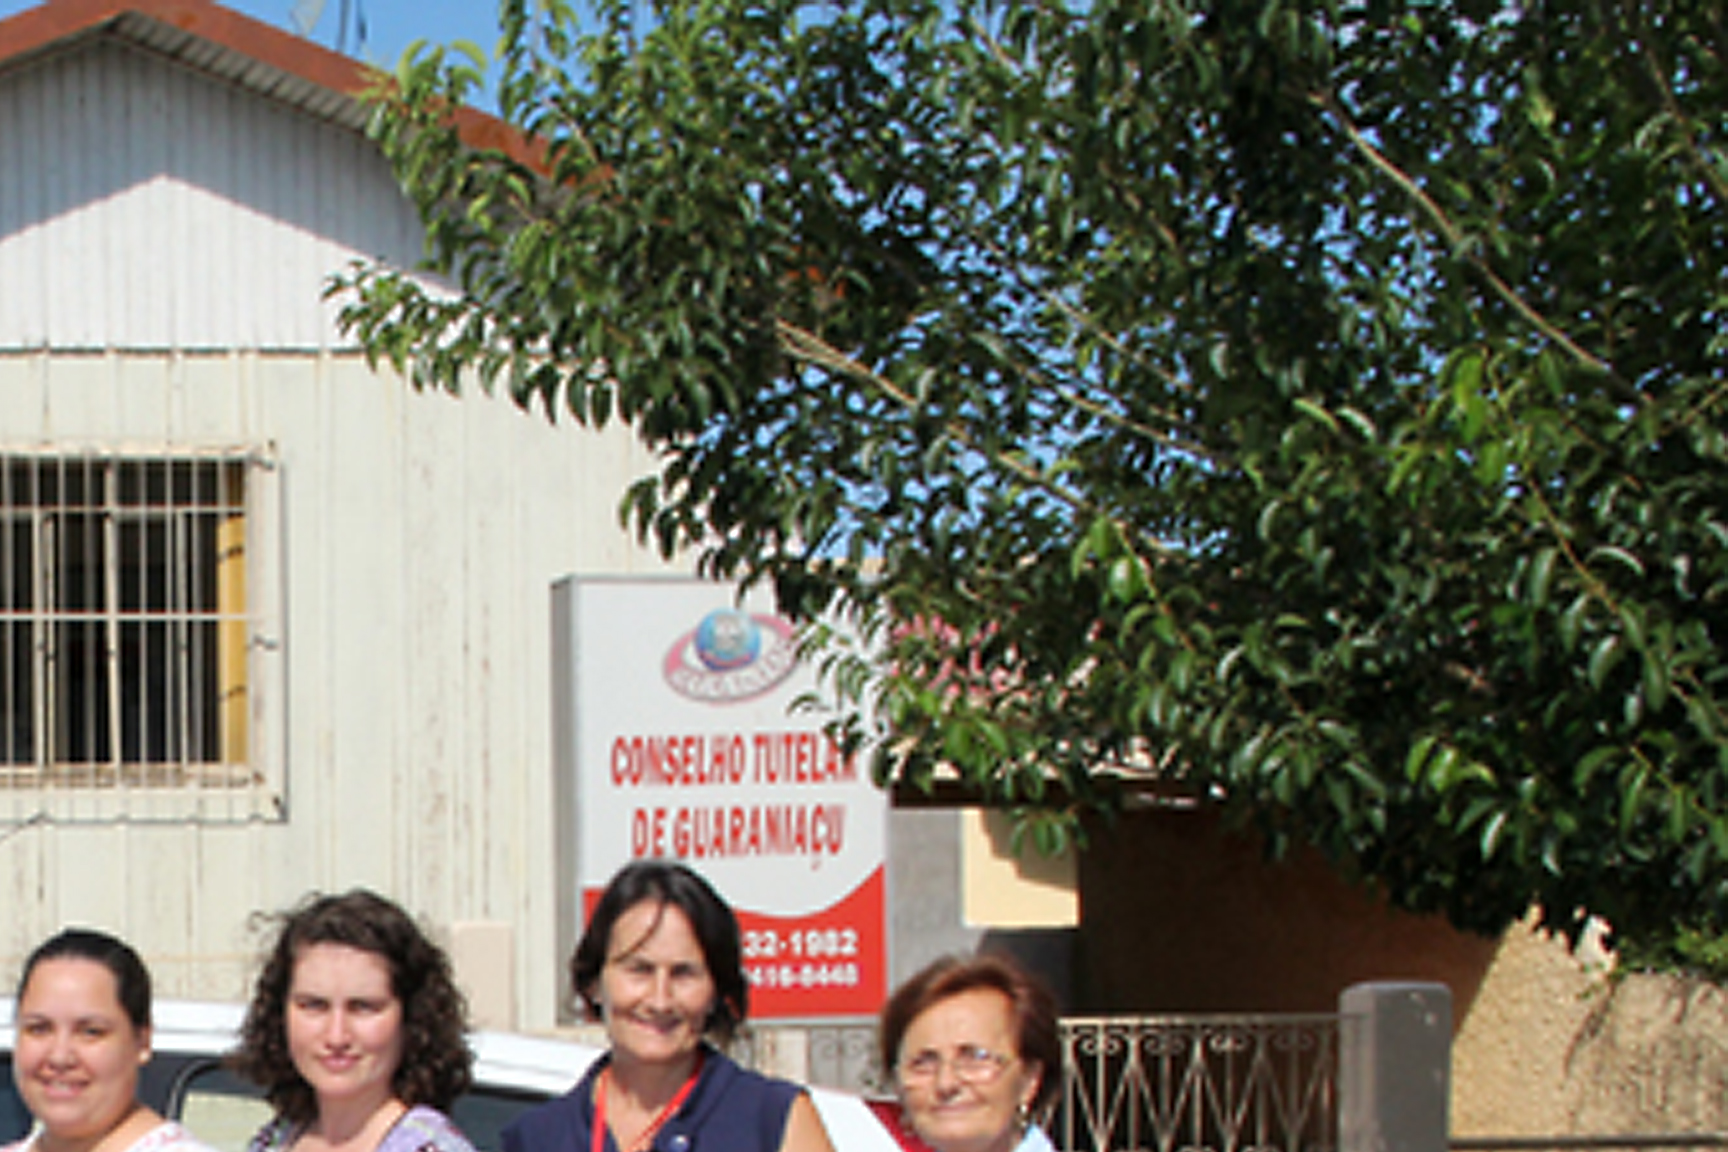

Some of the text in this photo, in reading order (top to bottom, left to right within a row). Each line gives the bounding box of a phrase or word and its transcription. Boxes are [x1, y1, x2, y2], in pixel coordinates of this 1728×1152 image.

[611, 735, 745, 785] CONSELHO
[632, 805, 844, 870] DE GUARANIAÇU
